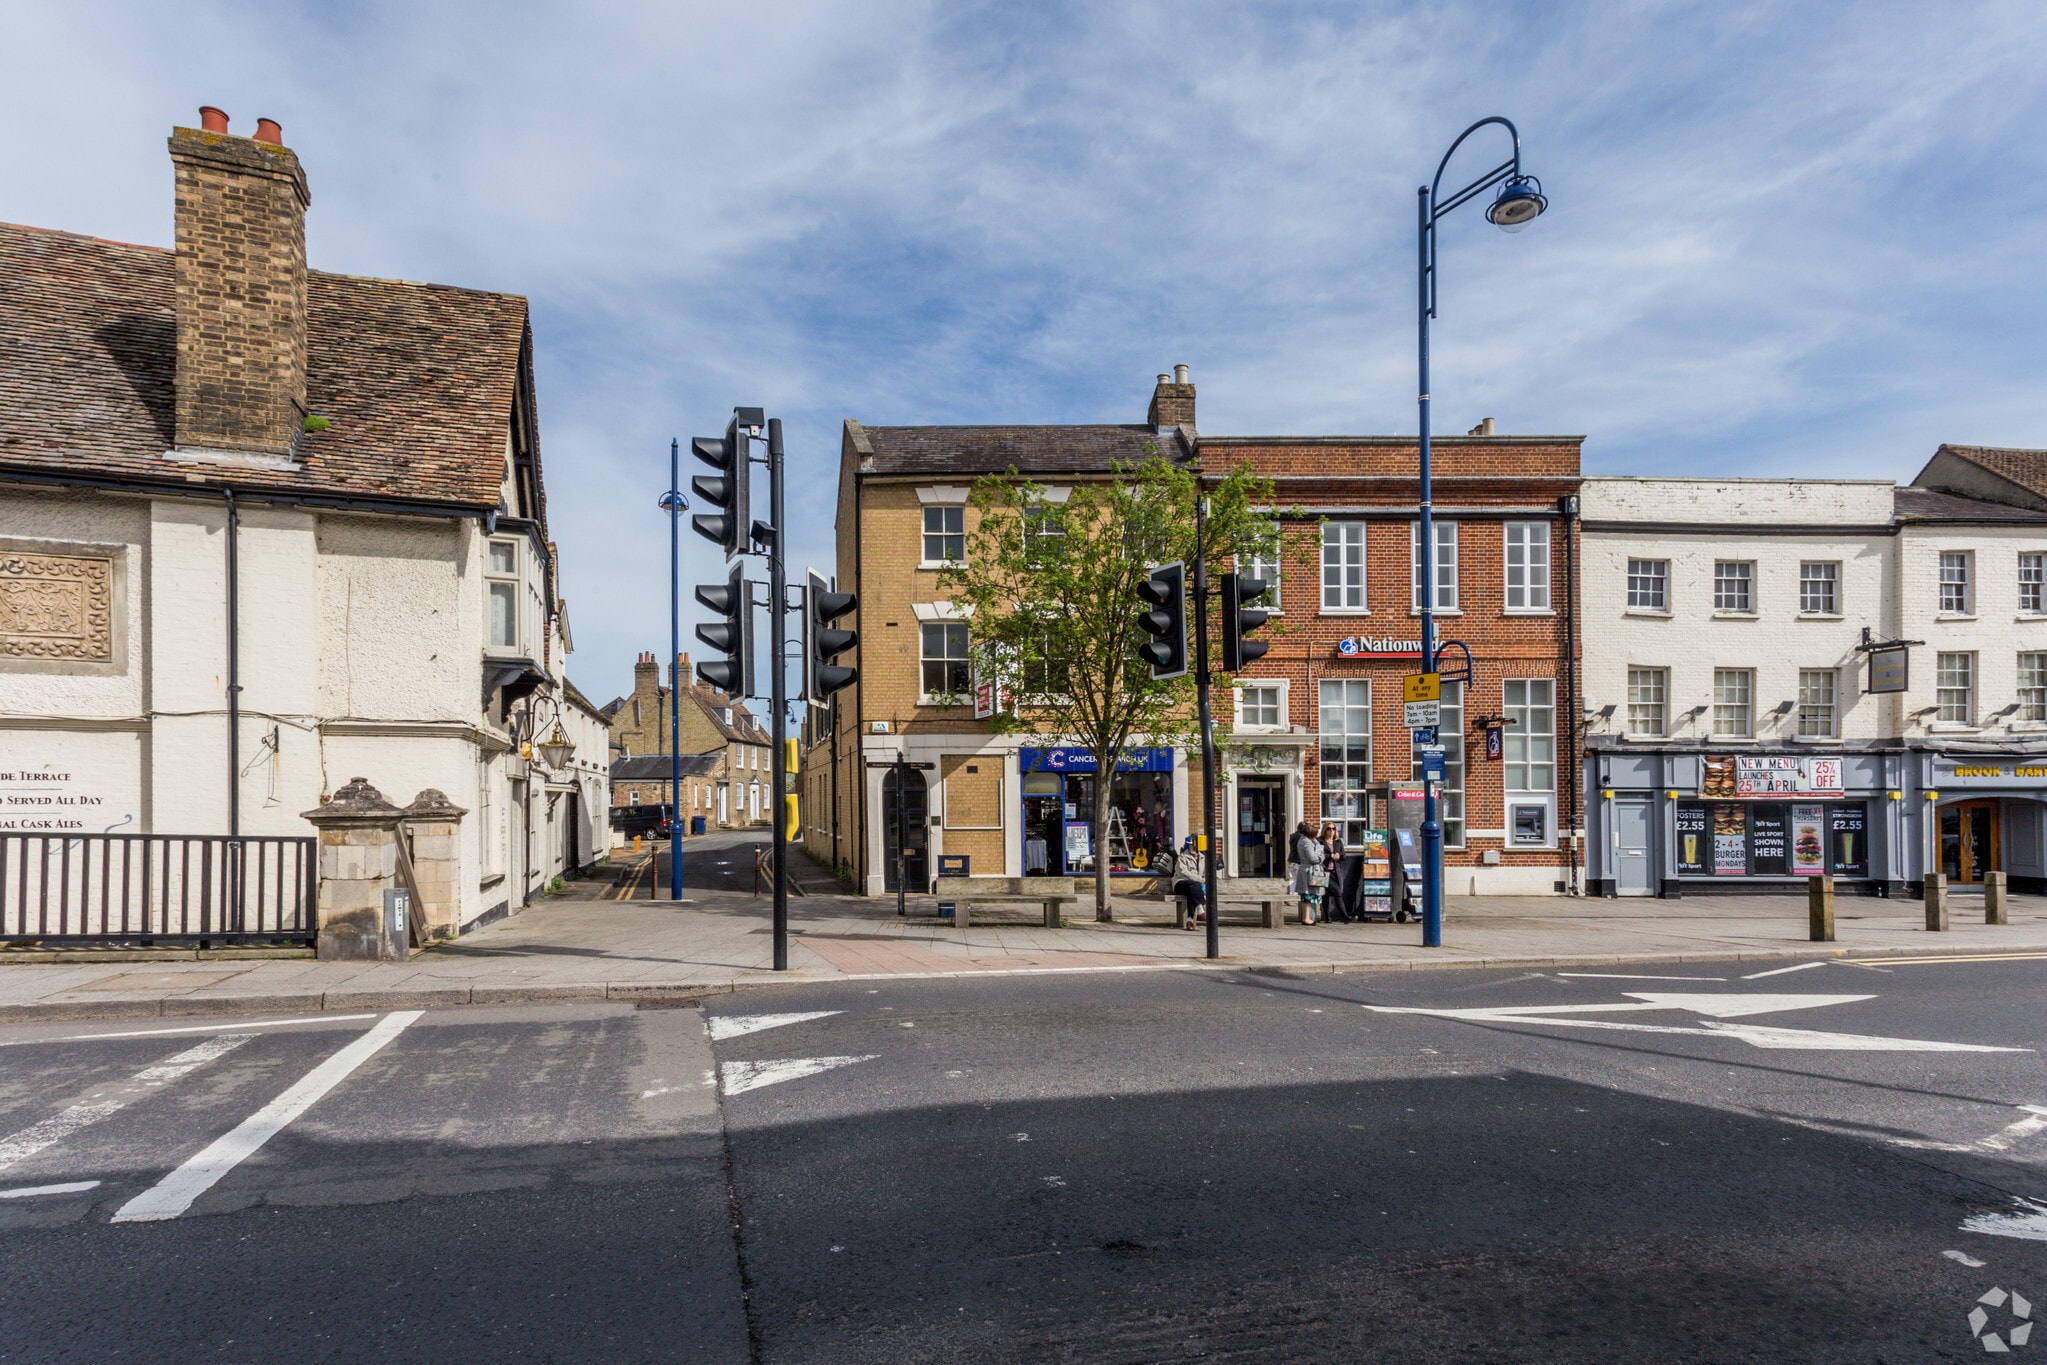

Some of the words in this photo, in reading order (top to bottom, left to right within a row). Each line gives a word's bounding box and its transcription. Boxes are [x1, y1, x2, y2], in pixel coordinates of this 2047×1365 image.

[1359, 636, 1448, 652] Nationwde
[1416, 703, 1438, 711] loading
[1740, 758, 1763, 769] NEW
[1815, 761, 1836, 774] 25%
[19, 770, 71, 781] TERRACE
[1739, 771, 1775, 780] LAUNCHES
[1955, 766, 2001, 777] BROOK
[1767, 779, 1799, 792] APRIL
[1816, 775, 1836, 788] OFF
[7, 795, 52, 805] SERVED
[55, 795, 76, 805] ALL
[80, 795, 104, 805] DAY
[21, 819, 52, 828] CASK
[55, 819, 83, 828] ALES
[1676, 821, 1705, 831] £2.55
[1833, 820, 1862, 830] £2.55
[1715, 850, 1745, 859] BURGER
[1754, 848, 1784, 857] HERE
